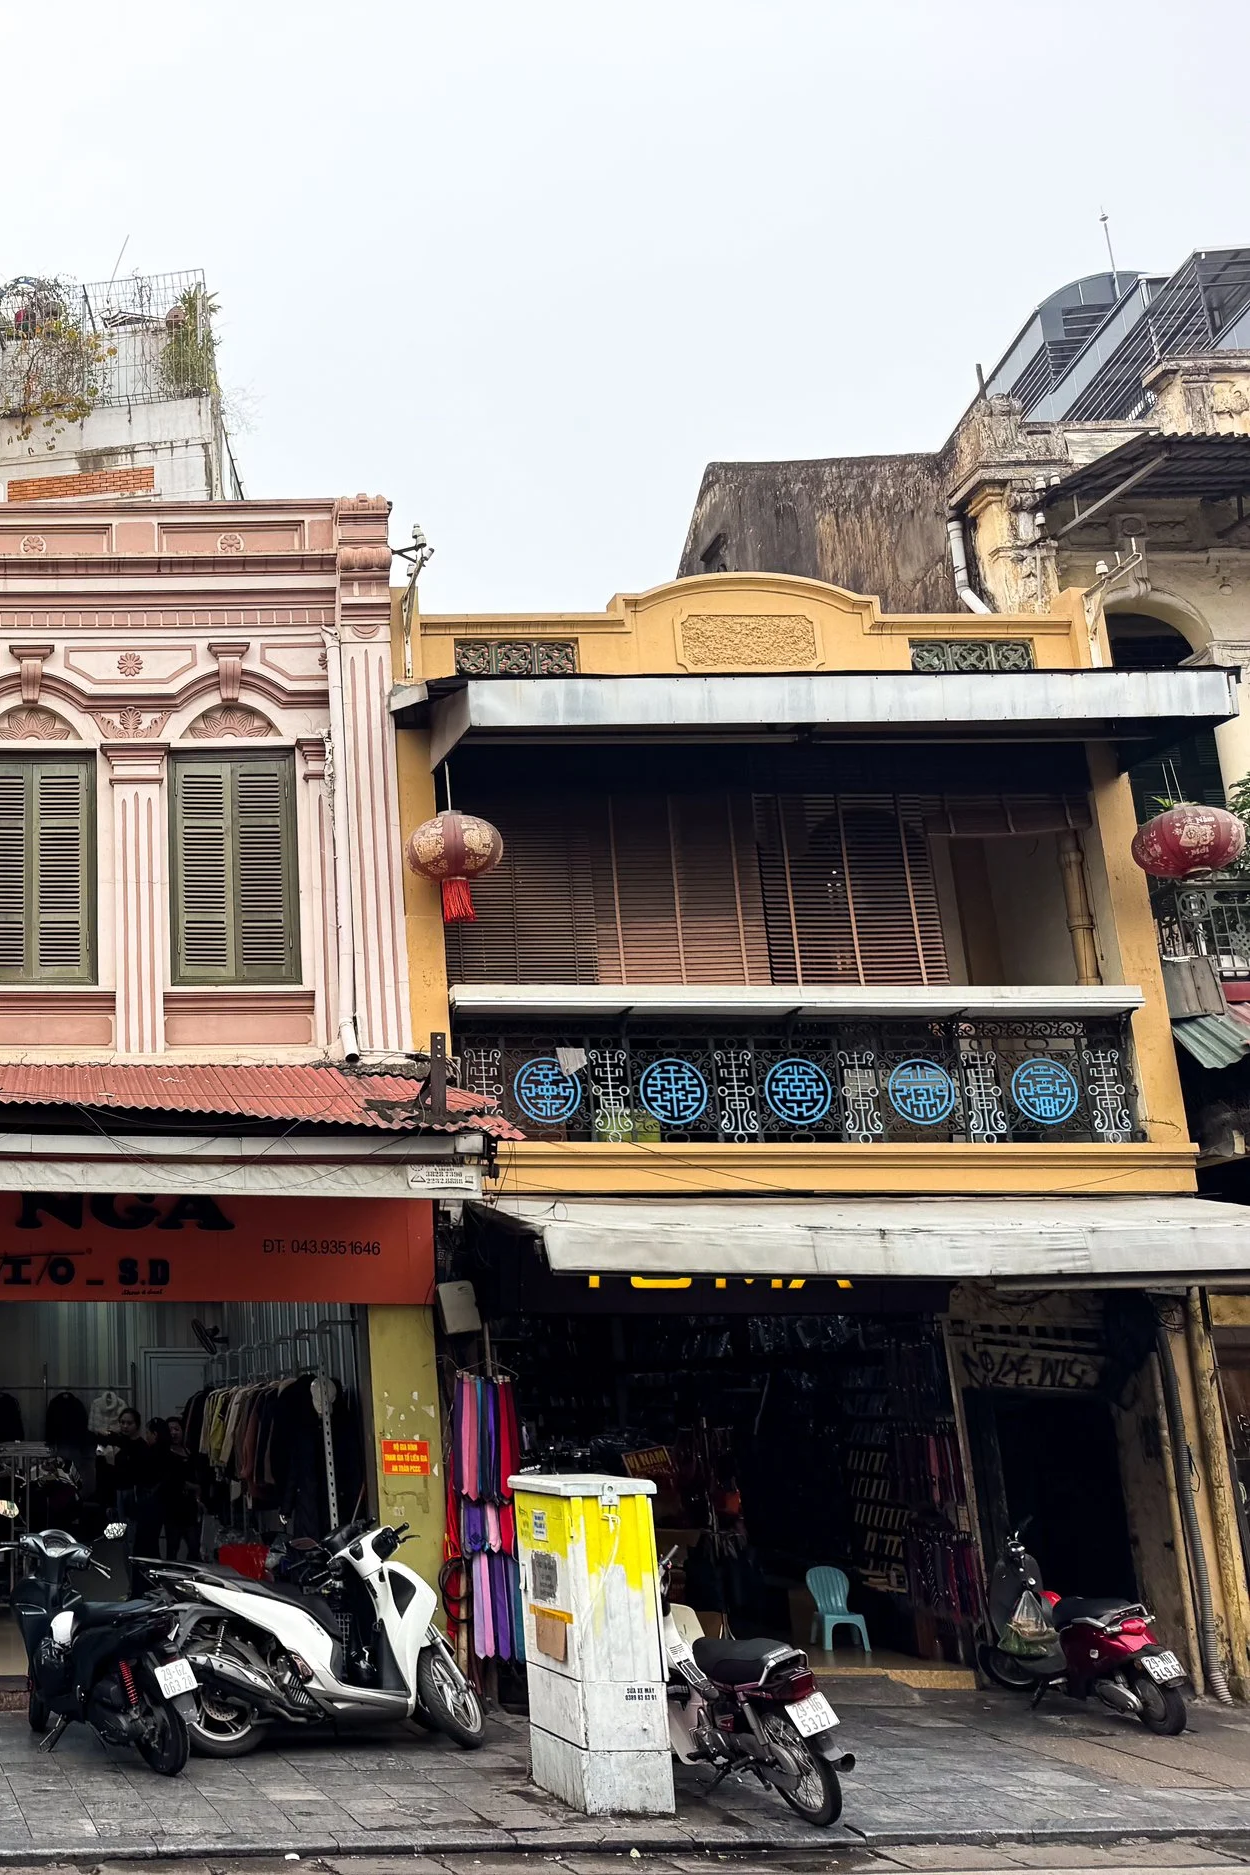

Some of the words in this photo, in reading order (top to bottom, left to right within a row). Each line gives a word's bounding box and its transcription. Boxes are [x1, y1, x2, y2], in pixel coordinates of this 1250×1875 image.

[262, 1239, 285, 1253] ĐT:
[291, 1239, 381, 1256] 043.9351646
[801, 1711, 831, 1733] 5327
